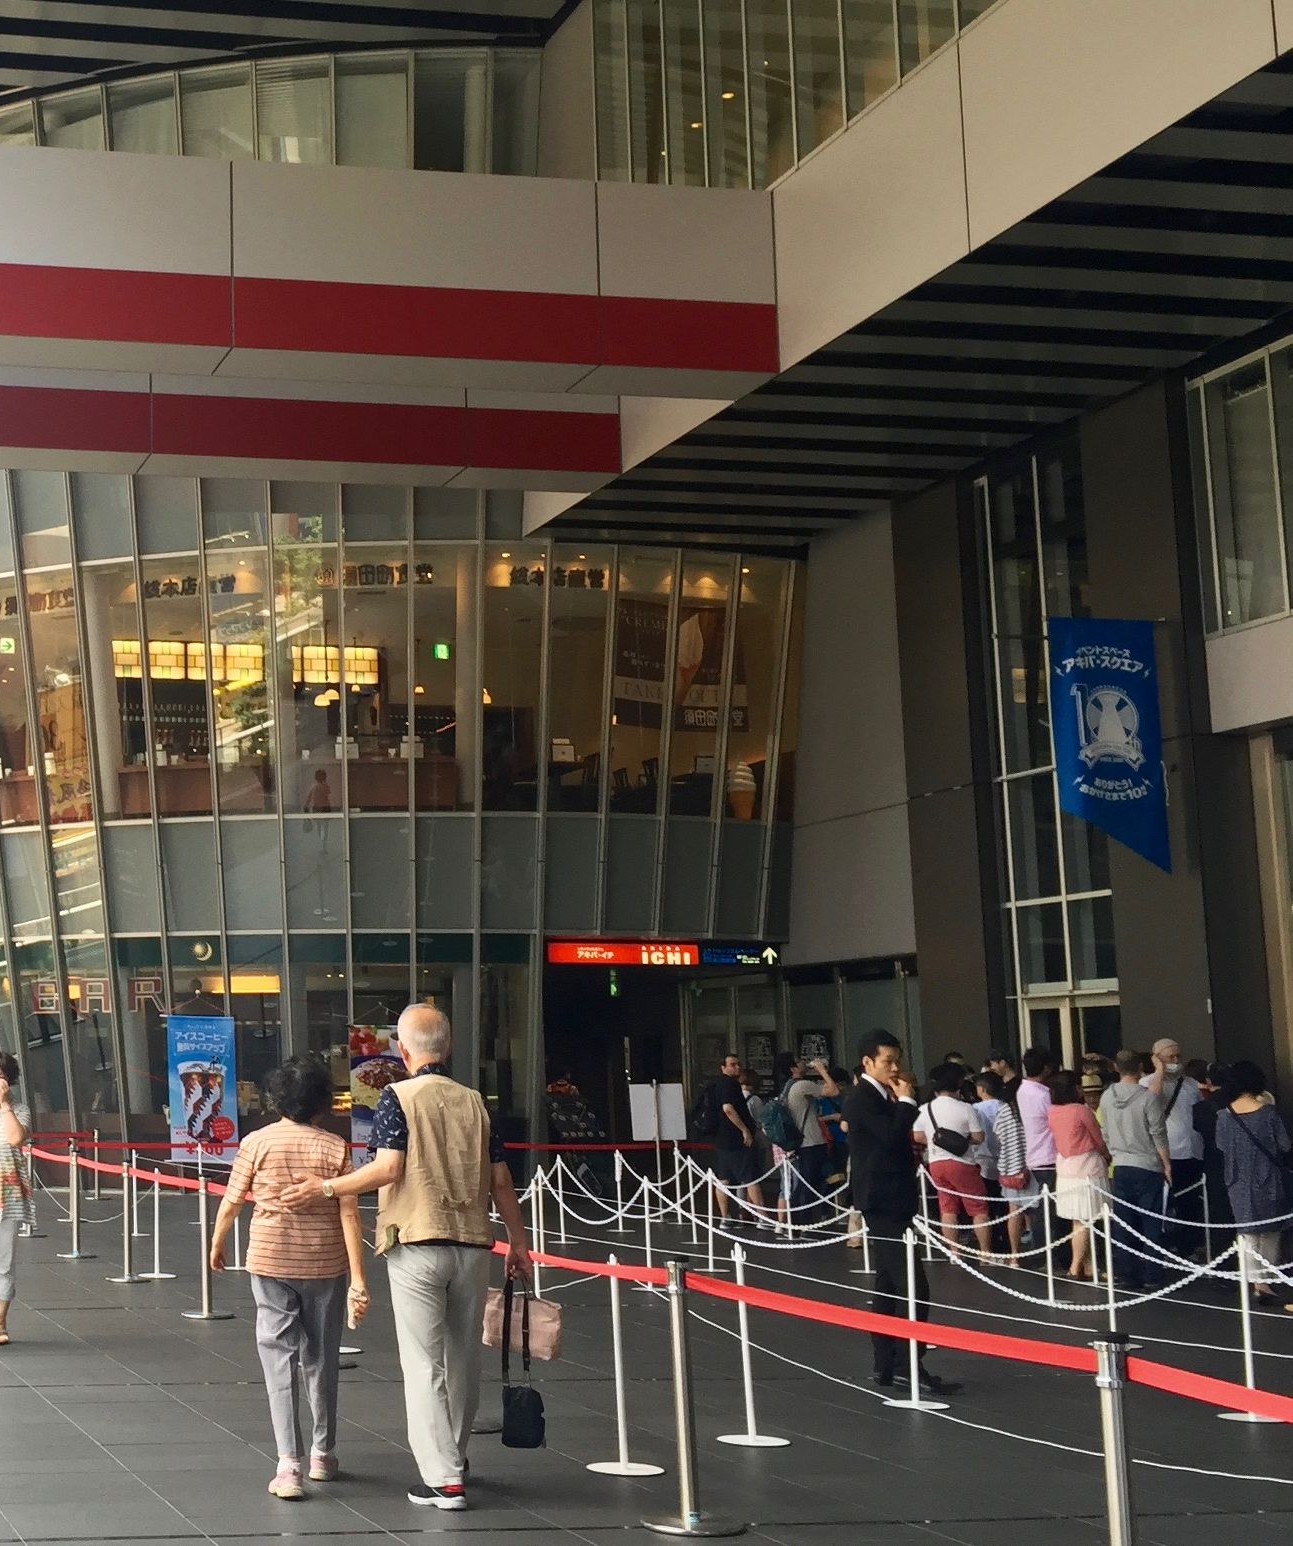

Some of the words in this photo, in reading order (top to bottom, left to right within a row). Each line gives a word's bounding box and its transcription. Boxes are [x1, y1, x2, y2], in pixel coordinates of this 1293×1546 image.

[1062, 655, 1144, 674] アキバ・スクエア
[641, 951, 691, 965] ICHI
[31, 977, 167, 1014] BAR
